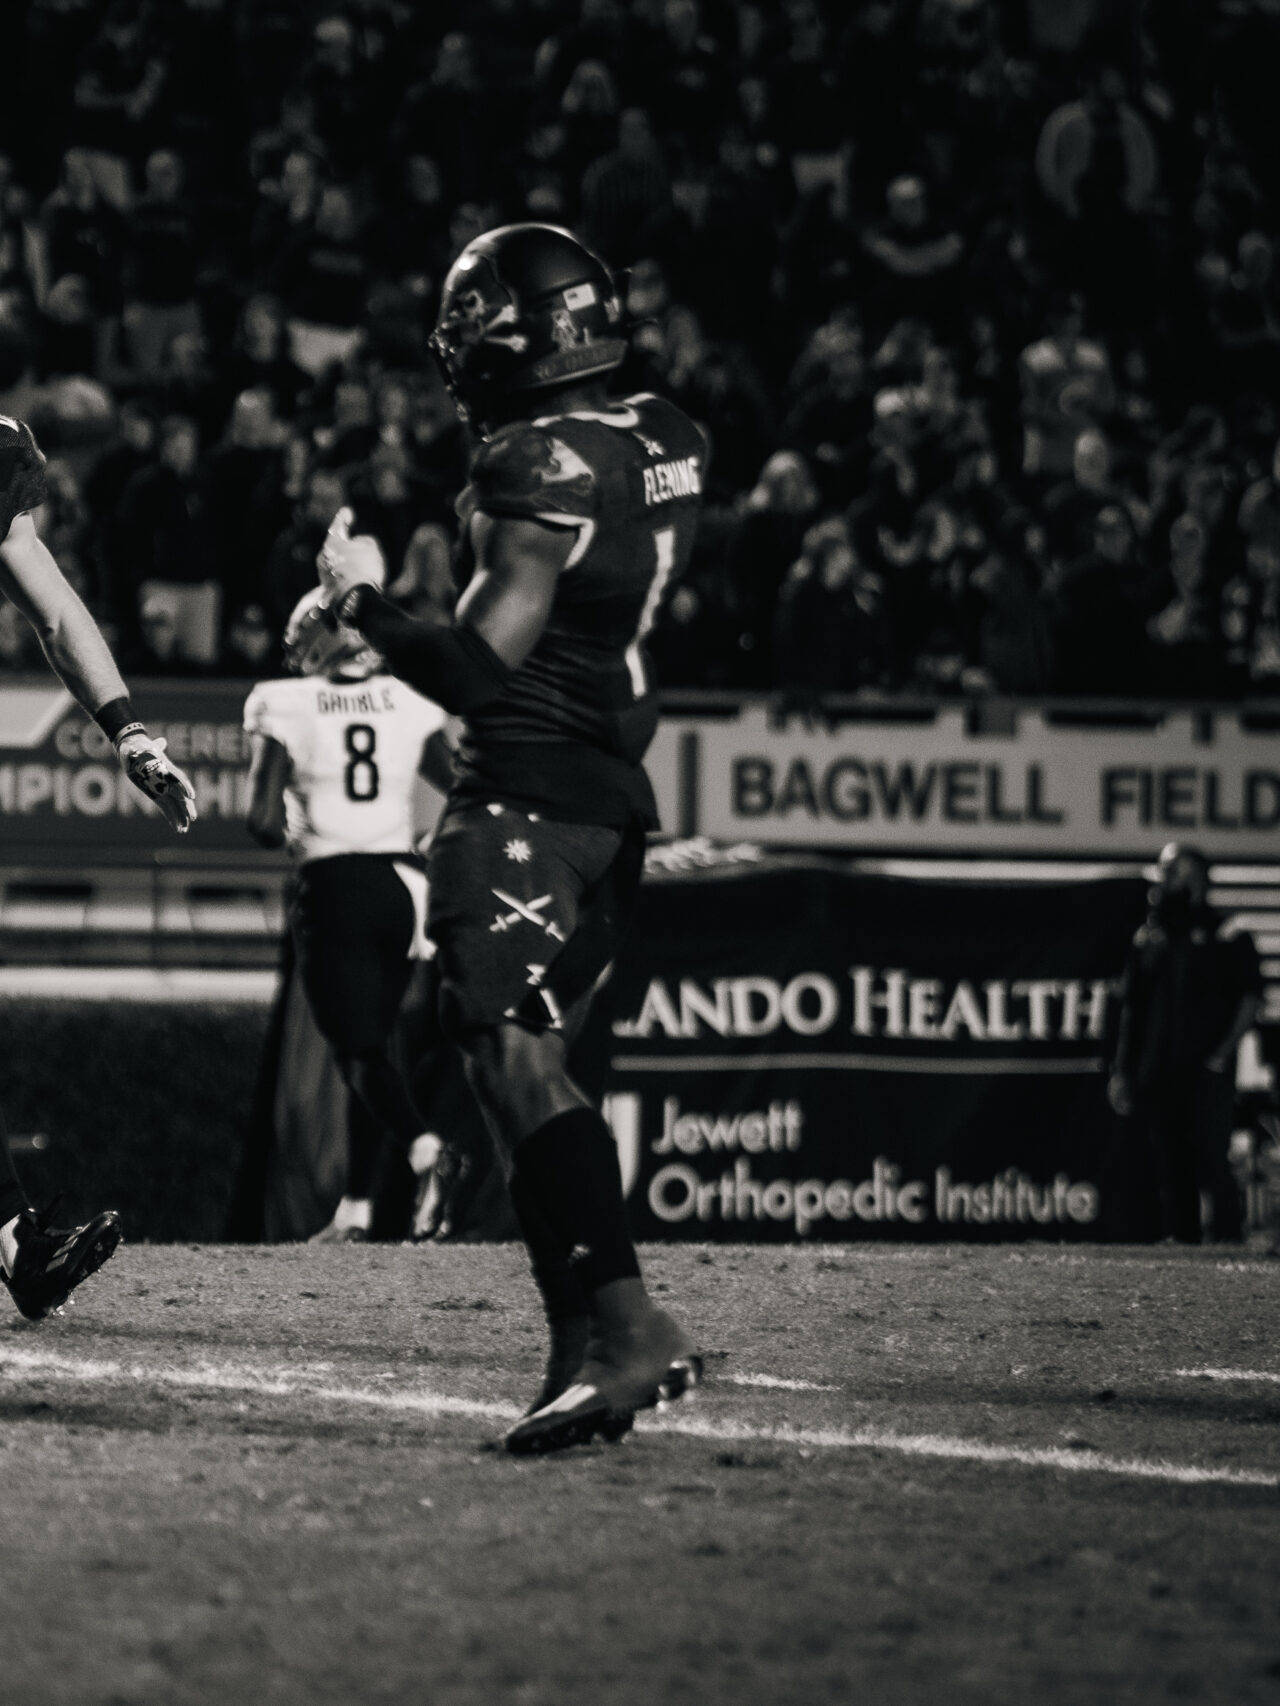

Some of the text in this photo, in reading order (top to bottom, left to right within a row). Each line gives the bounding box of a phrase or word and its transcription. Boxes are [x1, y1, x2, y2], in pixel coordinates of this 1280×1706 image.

[643, 456, 701, 506] FLEMING
[624, 524, 675, 700] 1
[346, 725, 379, 801] 8
[732, 757, 1280, 831] BAGWELL FIELD
[651, 1095, 803, 1155] Jewett
[648, 1155, 1100, 1236] Orthopedic Institute
